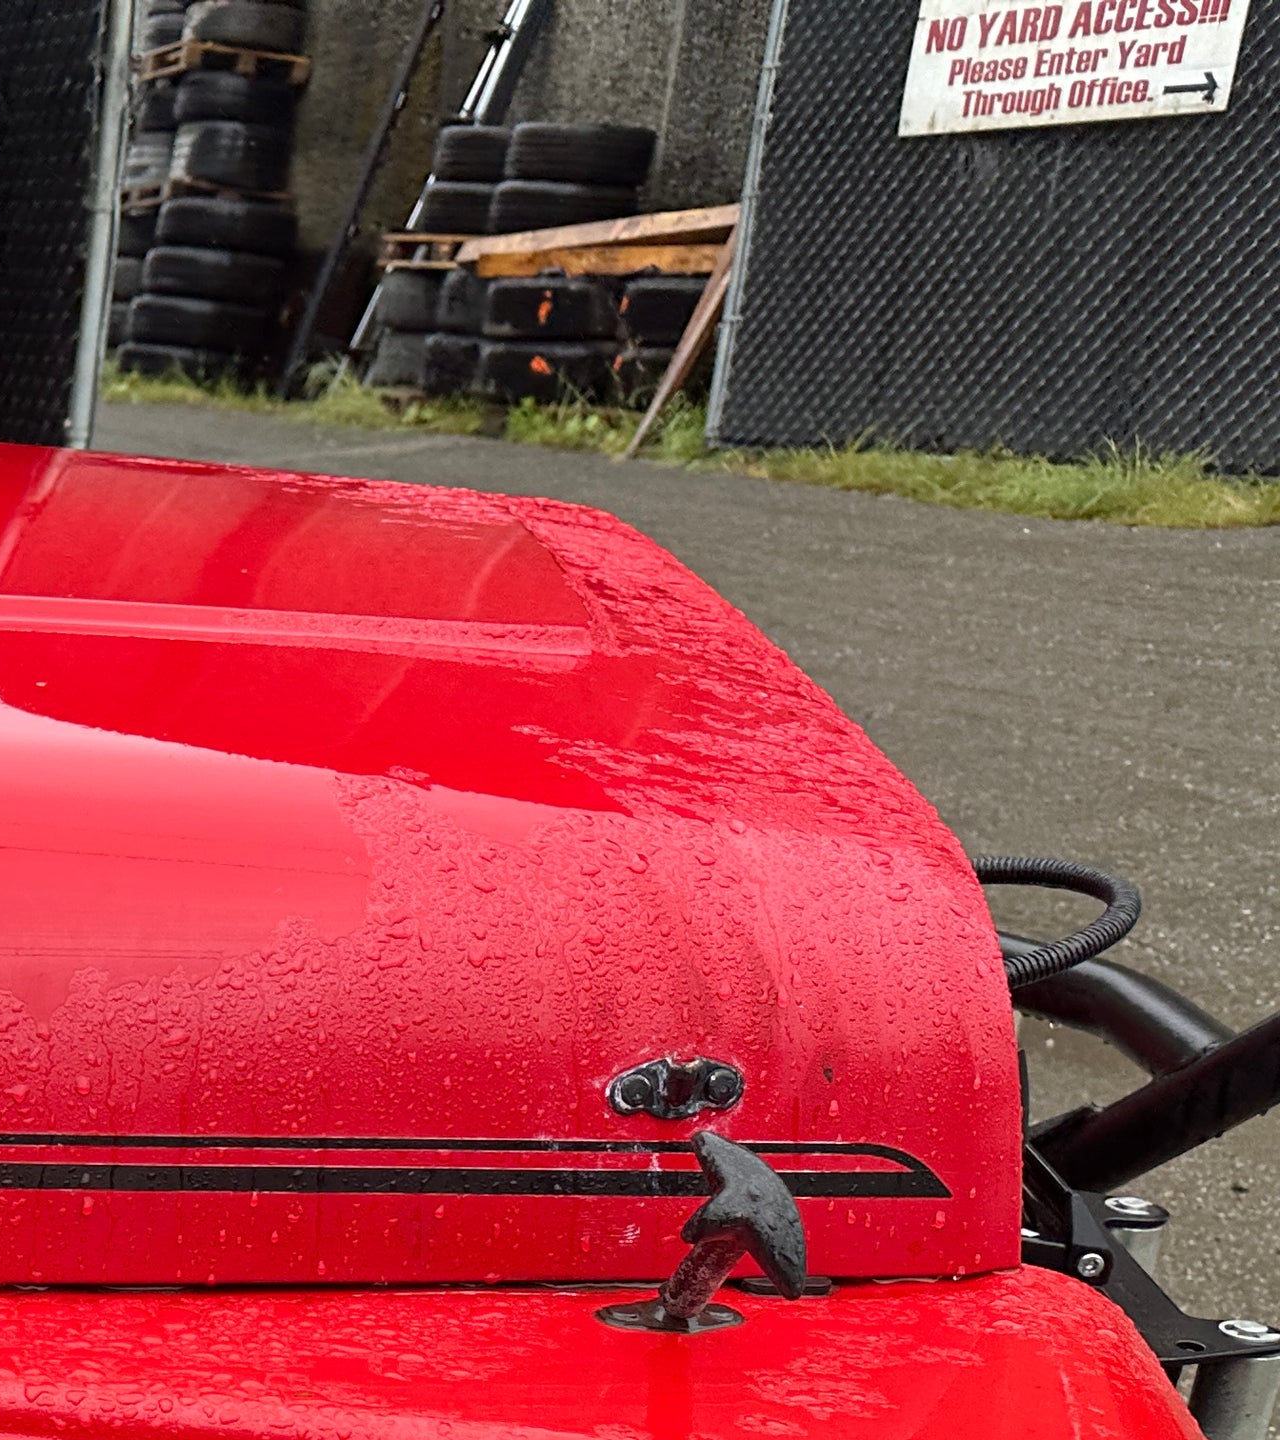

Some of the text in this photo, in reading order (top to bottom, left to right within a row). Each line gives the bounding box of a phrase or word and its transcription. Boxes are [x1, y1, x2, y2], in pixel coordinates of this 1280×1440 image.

[925, 0, 1231, 53] NO YARD ACCESS!!!
[948, 35, 1187, 86] Please Enter Yard
[962, 77, 1153, 118] Through Office.
